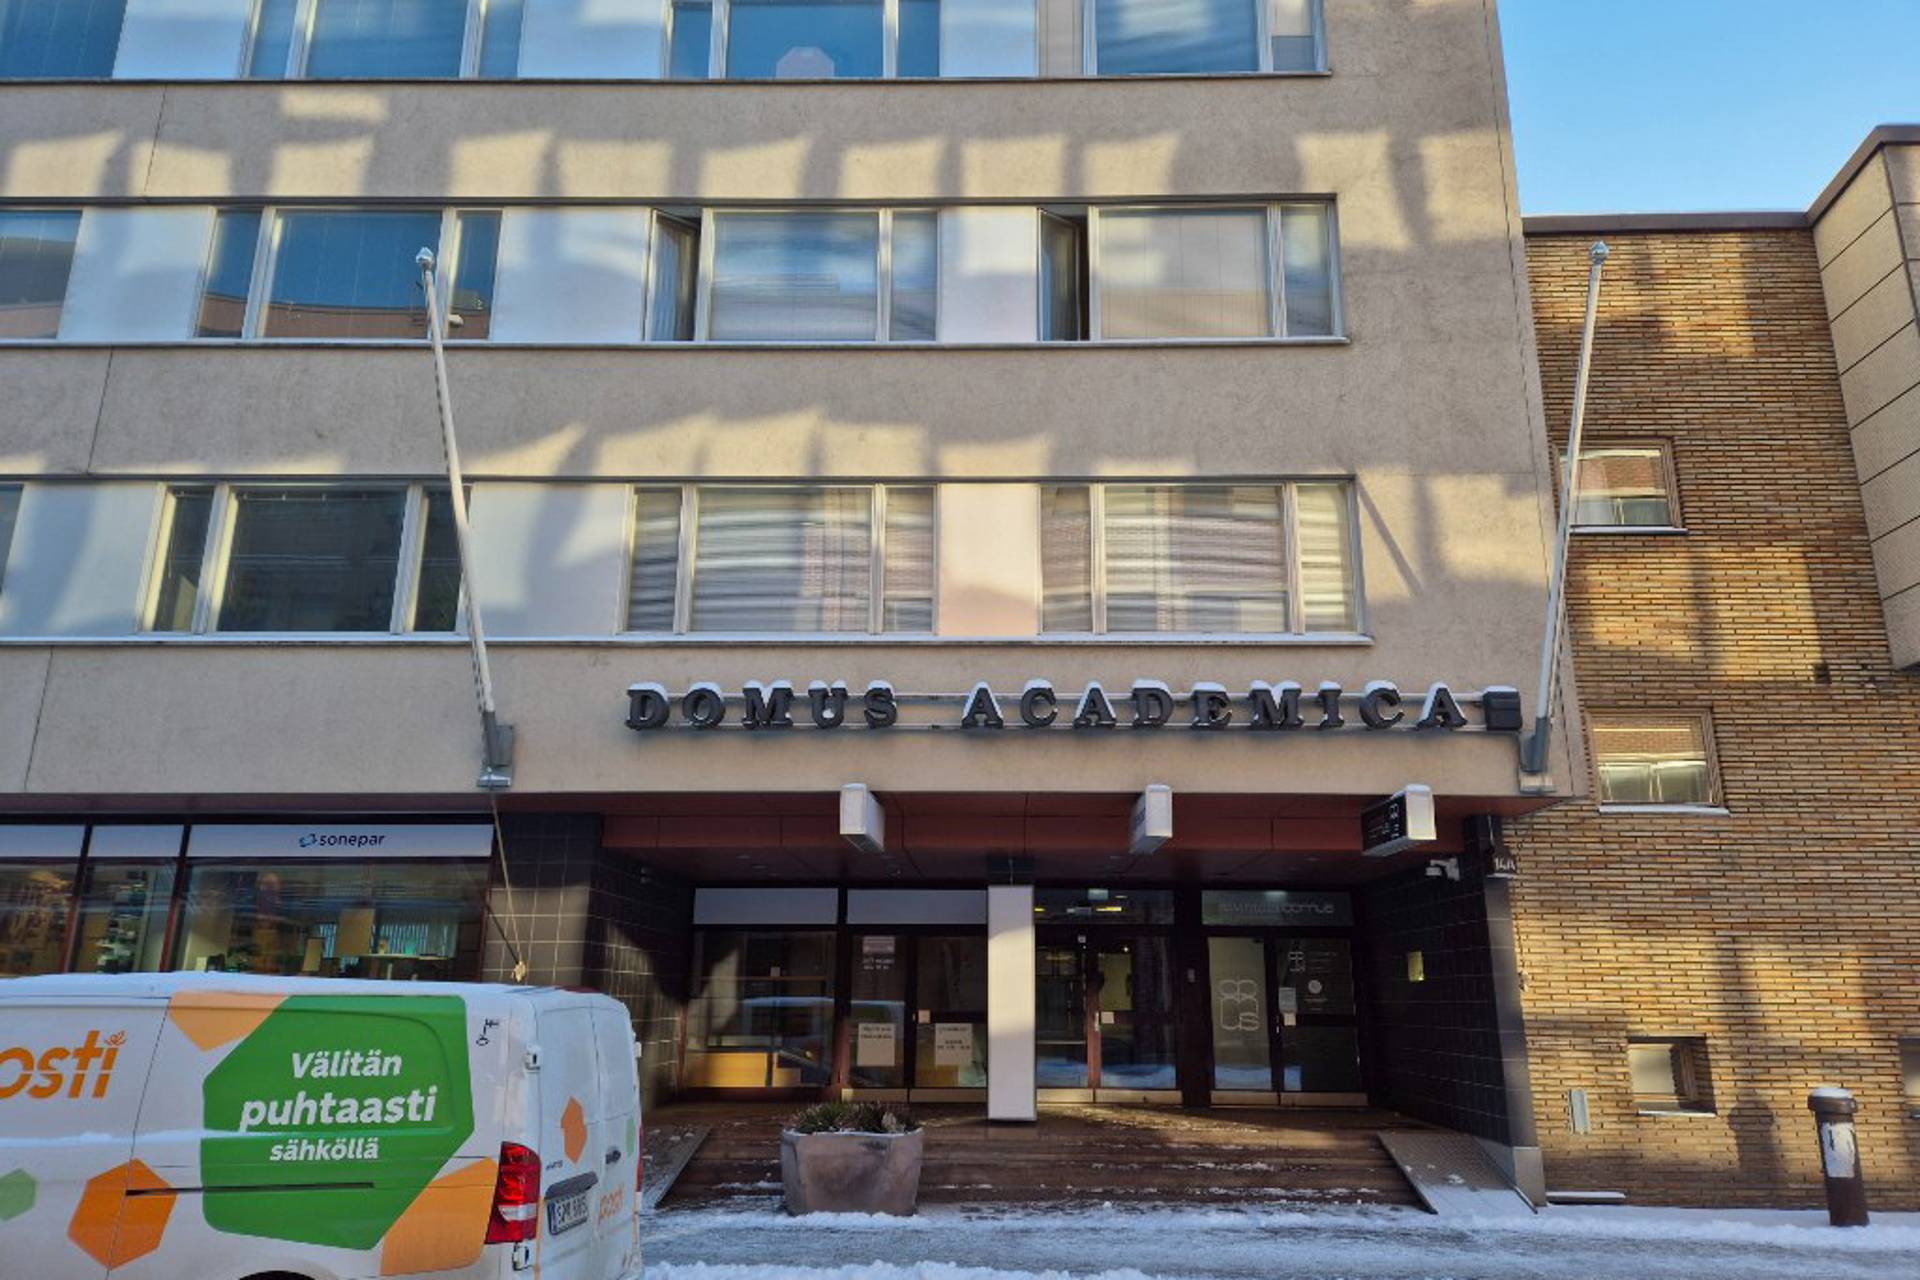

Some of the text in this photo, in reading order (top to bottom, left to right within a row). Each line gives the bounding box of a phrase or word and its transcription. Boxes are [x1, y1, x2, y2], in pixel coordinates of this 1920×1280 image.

[624, 680, 1468, 731] DOMUS ACADEMICA
[320, 834, 385, 847] sonepar
[292, 1049, 402, 1078] Välitän
[239, 1085, 438, 1133] puhtaasti
[269, 1137, 379, 1161] sähköllä
